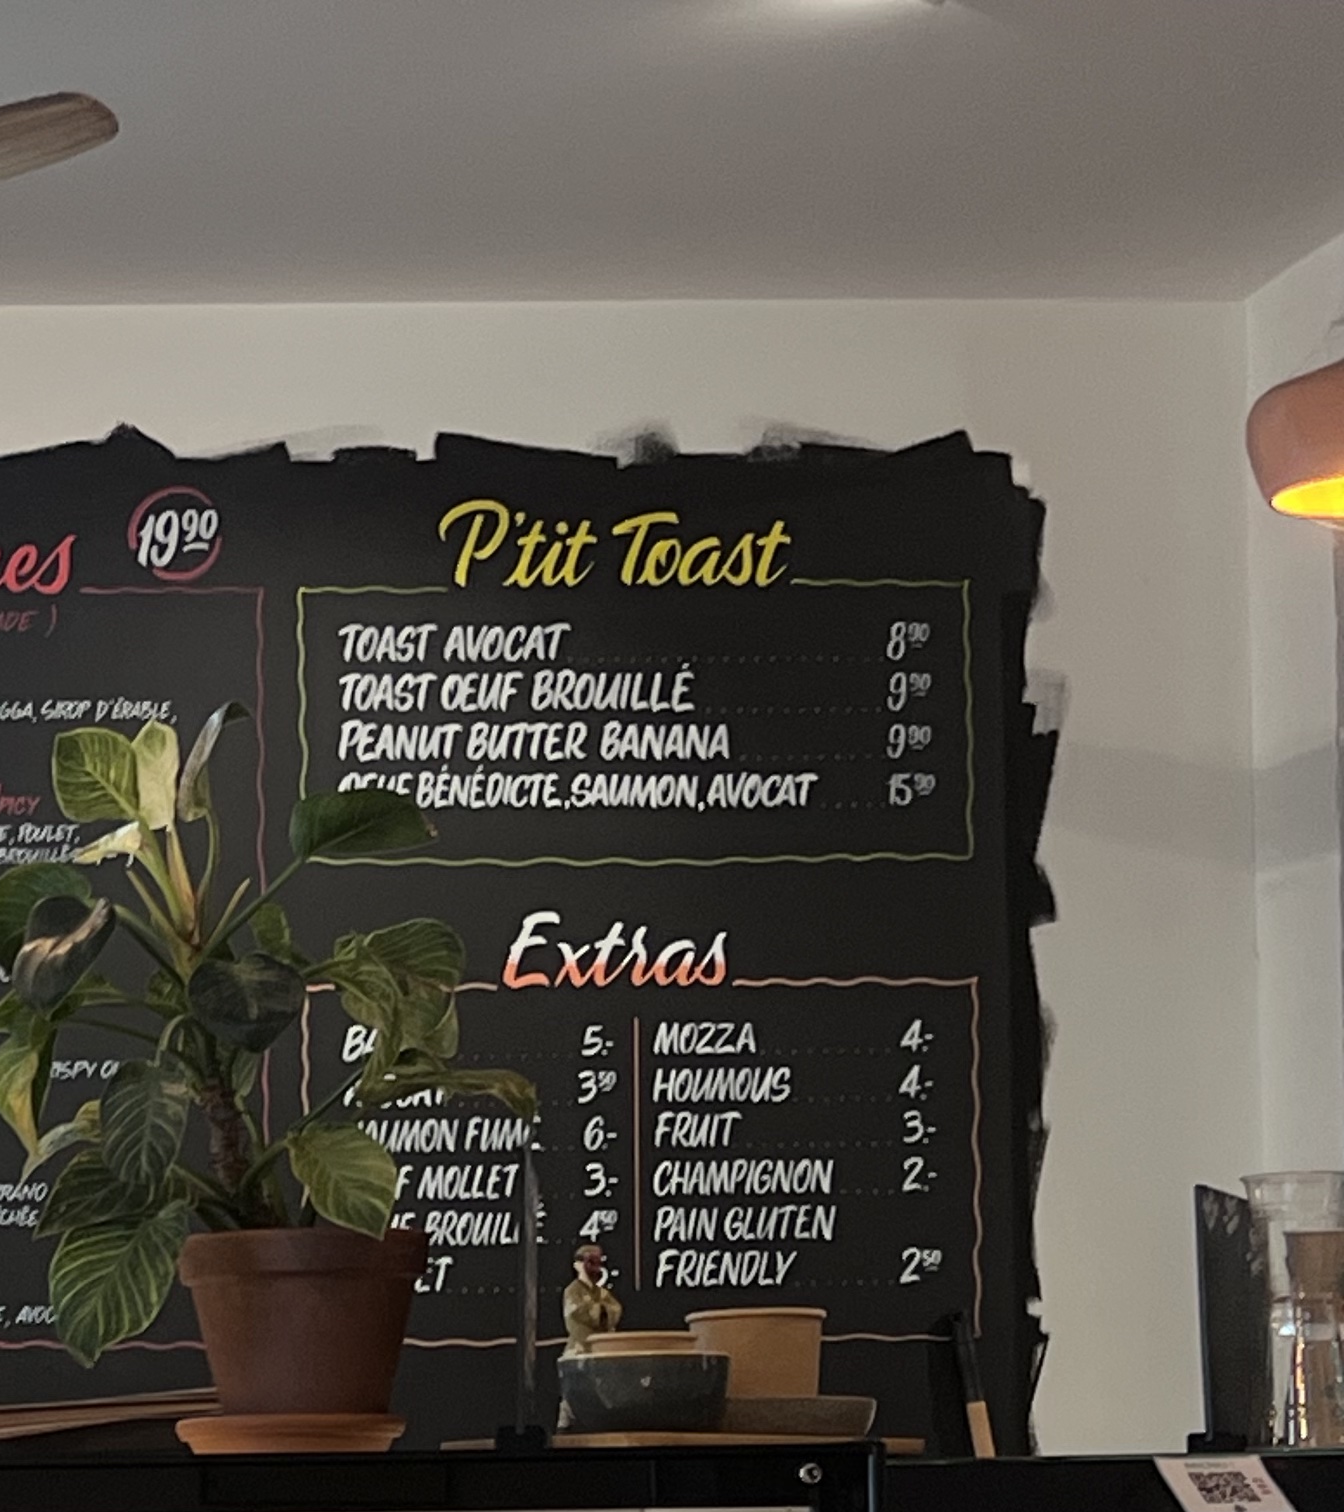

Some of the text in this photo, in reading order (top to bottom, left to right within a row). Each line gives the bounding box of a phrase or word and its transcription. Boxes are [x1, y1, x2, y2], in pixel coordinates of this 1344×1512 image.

[437, 498, 792, 588] P'tit Toast
[337, 623, 437, 661] TOAST
[443, 623, 571, 661] AVOCAT
[337, 672, 437, 711] TOAST
[530, 662, 695, 712] BROUILLÉ
[337, 720, 463, 761] PEANUT
[466, 720, 587, 761] BUTTER
[600, 720, 730, 761] BANANA
[708, 773, 818, 807] AVOCAT
[501, 910, 729, 989] Extras
[653, 1021, 757, 1056] MOZZA
[653, 1066, 791, 1103] HOUMOUS
[358, 1118, 459, 1152] AUMON
[654, 1111, 742, 1148] FRUIT
[417, 1164, 520, 1200] MOLLET
[652, 1159, 833, 1197] CHAMPIGNON
[654, 1204, 836, 1242] PAIN GLUTEN
[656, 1249, 797, 1288] FRIENDLY
